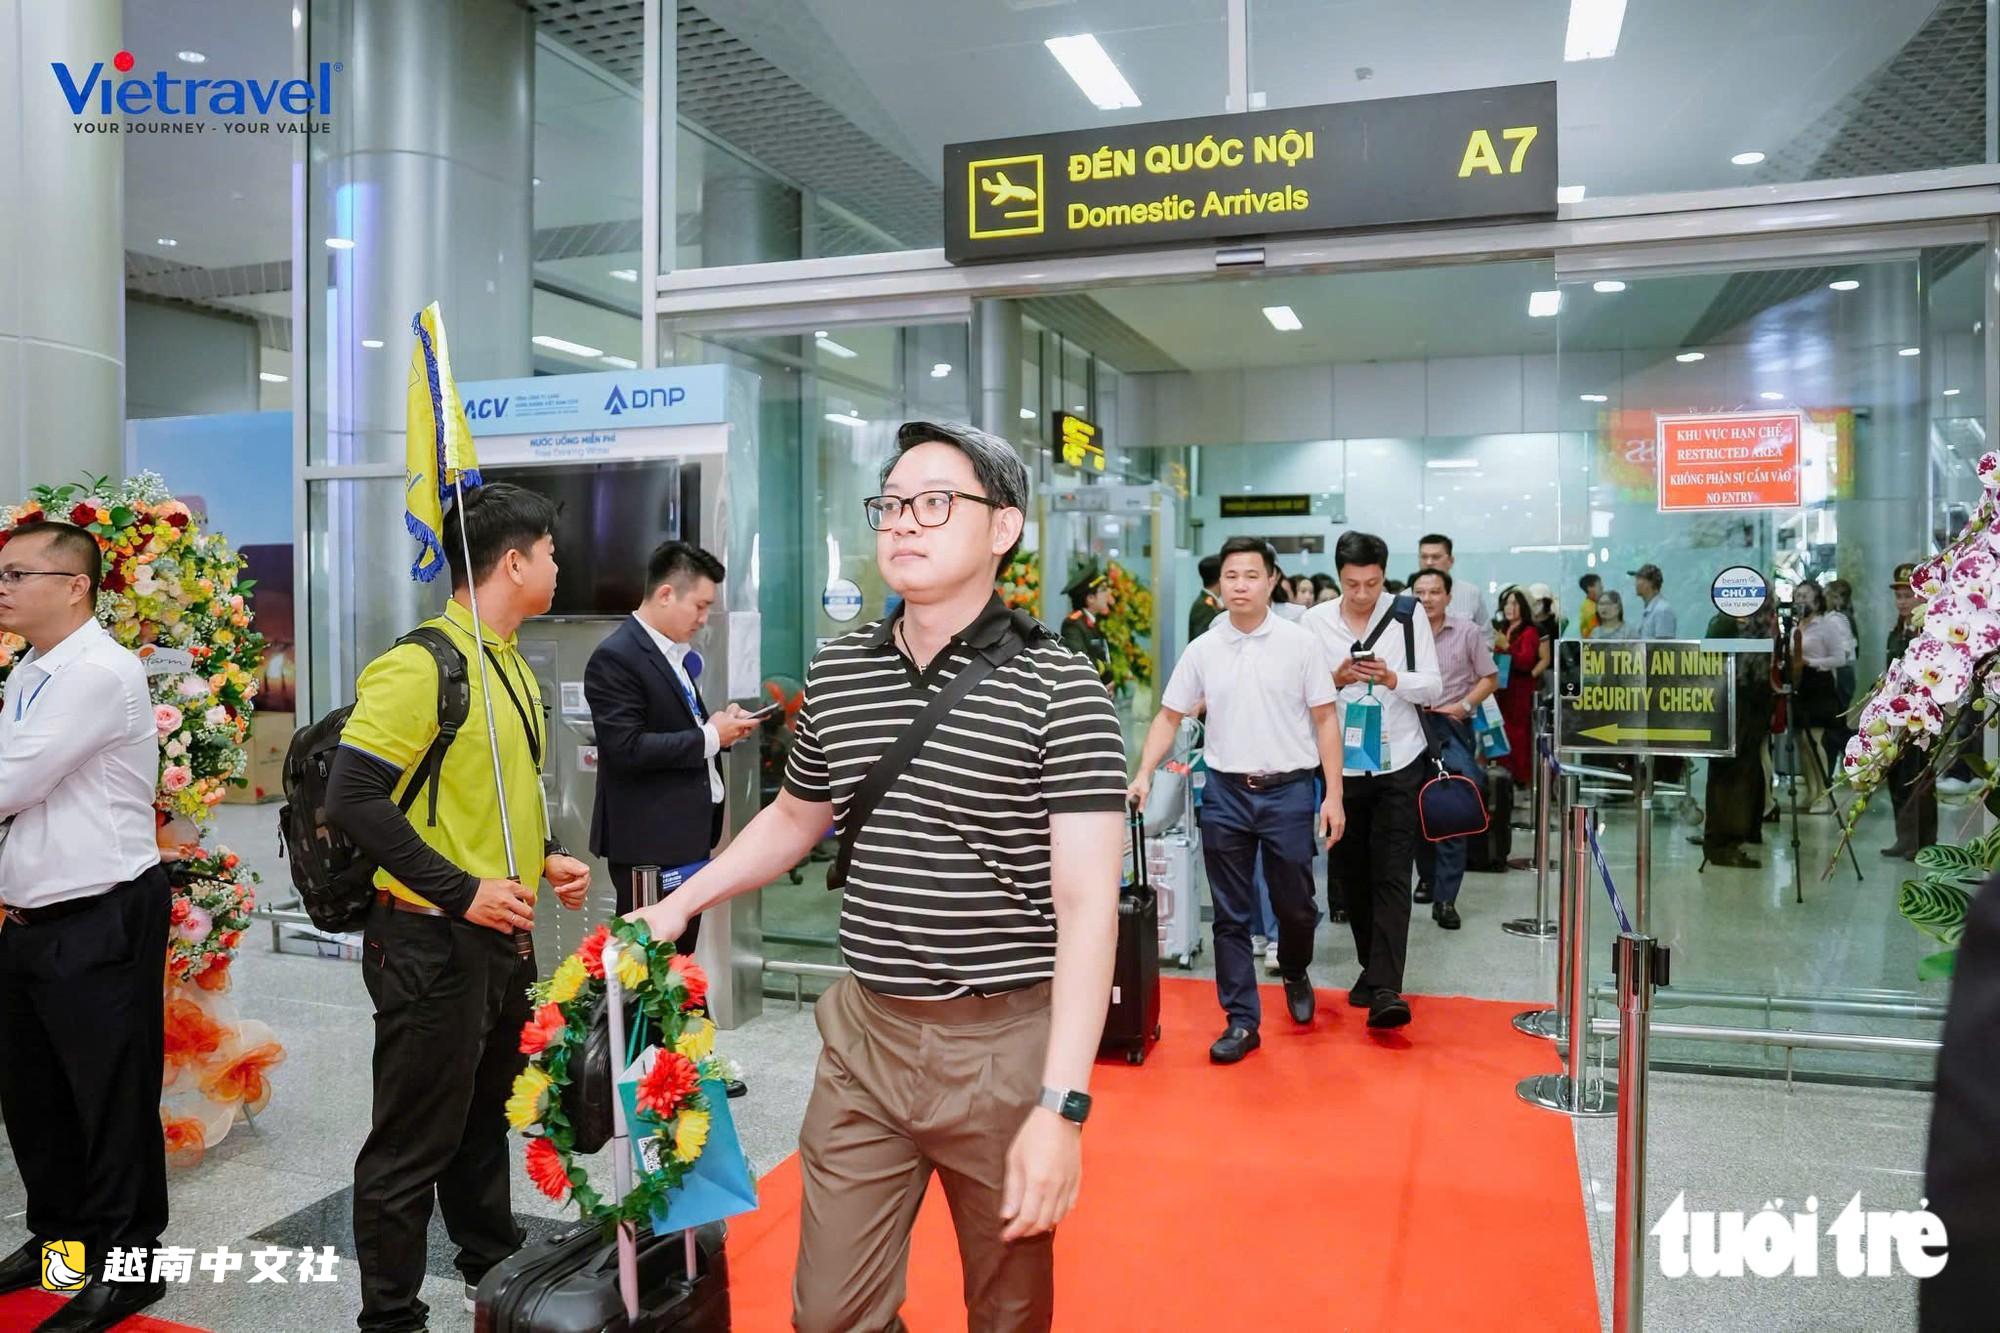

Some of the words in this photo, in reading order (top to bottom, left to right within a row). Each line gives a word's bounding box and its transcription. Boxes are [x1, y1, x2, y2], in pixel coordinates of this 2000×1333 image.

[1254, 129, 1314, 167] NỘI
[1458, 126, 1538, 177] A7
[1067, 195, 1196, 230] Domestic
[1201, 185, 1310, 218] Arrivals
[464, 397, 509, 419] ACV
[1677, 429, 1702, 441] KHU
[1731, 426, 1756, 441] HẠN
[1677, 446, 1749, 460] RESTRICTED
[1751, 445, 1783, 457] AREA
[1670, 471, 1704, 485] KHÔNG
[1706, 493, 1720, 504] NO
[1722, 491, 1754, 503] ENTRY
[1721, 586, 1747, 597] CHÚ
[1750, 586, 1758, 597] Ý
[1583, 643, 1606, 675] ỂM
[1611, 651, 1645, 675] TRA
[1651, 651, 1675, 675] AN
[1681, 651, 1723, 676] NINH
[1659, 687, 1715, 712] CHECK
